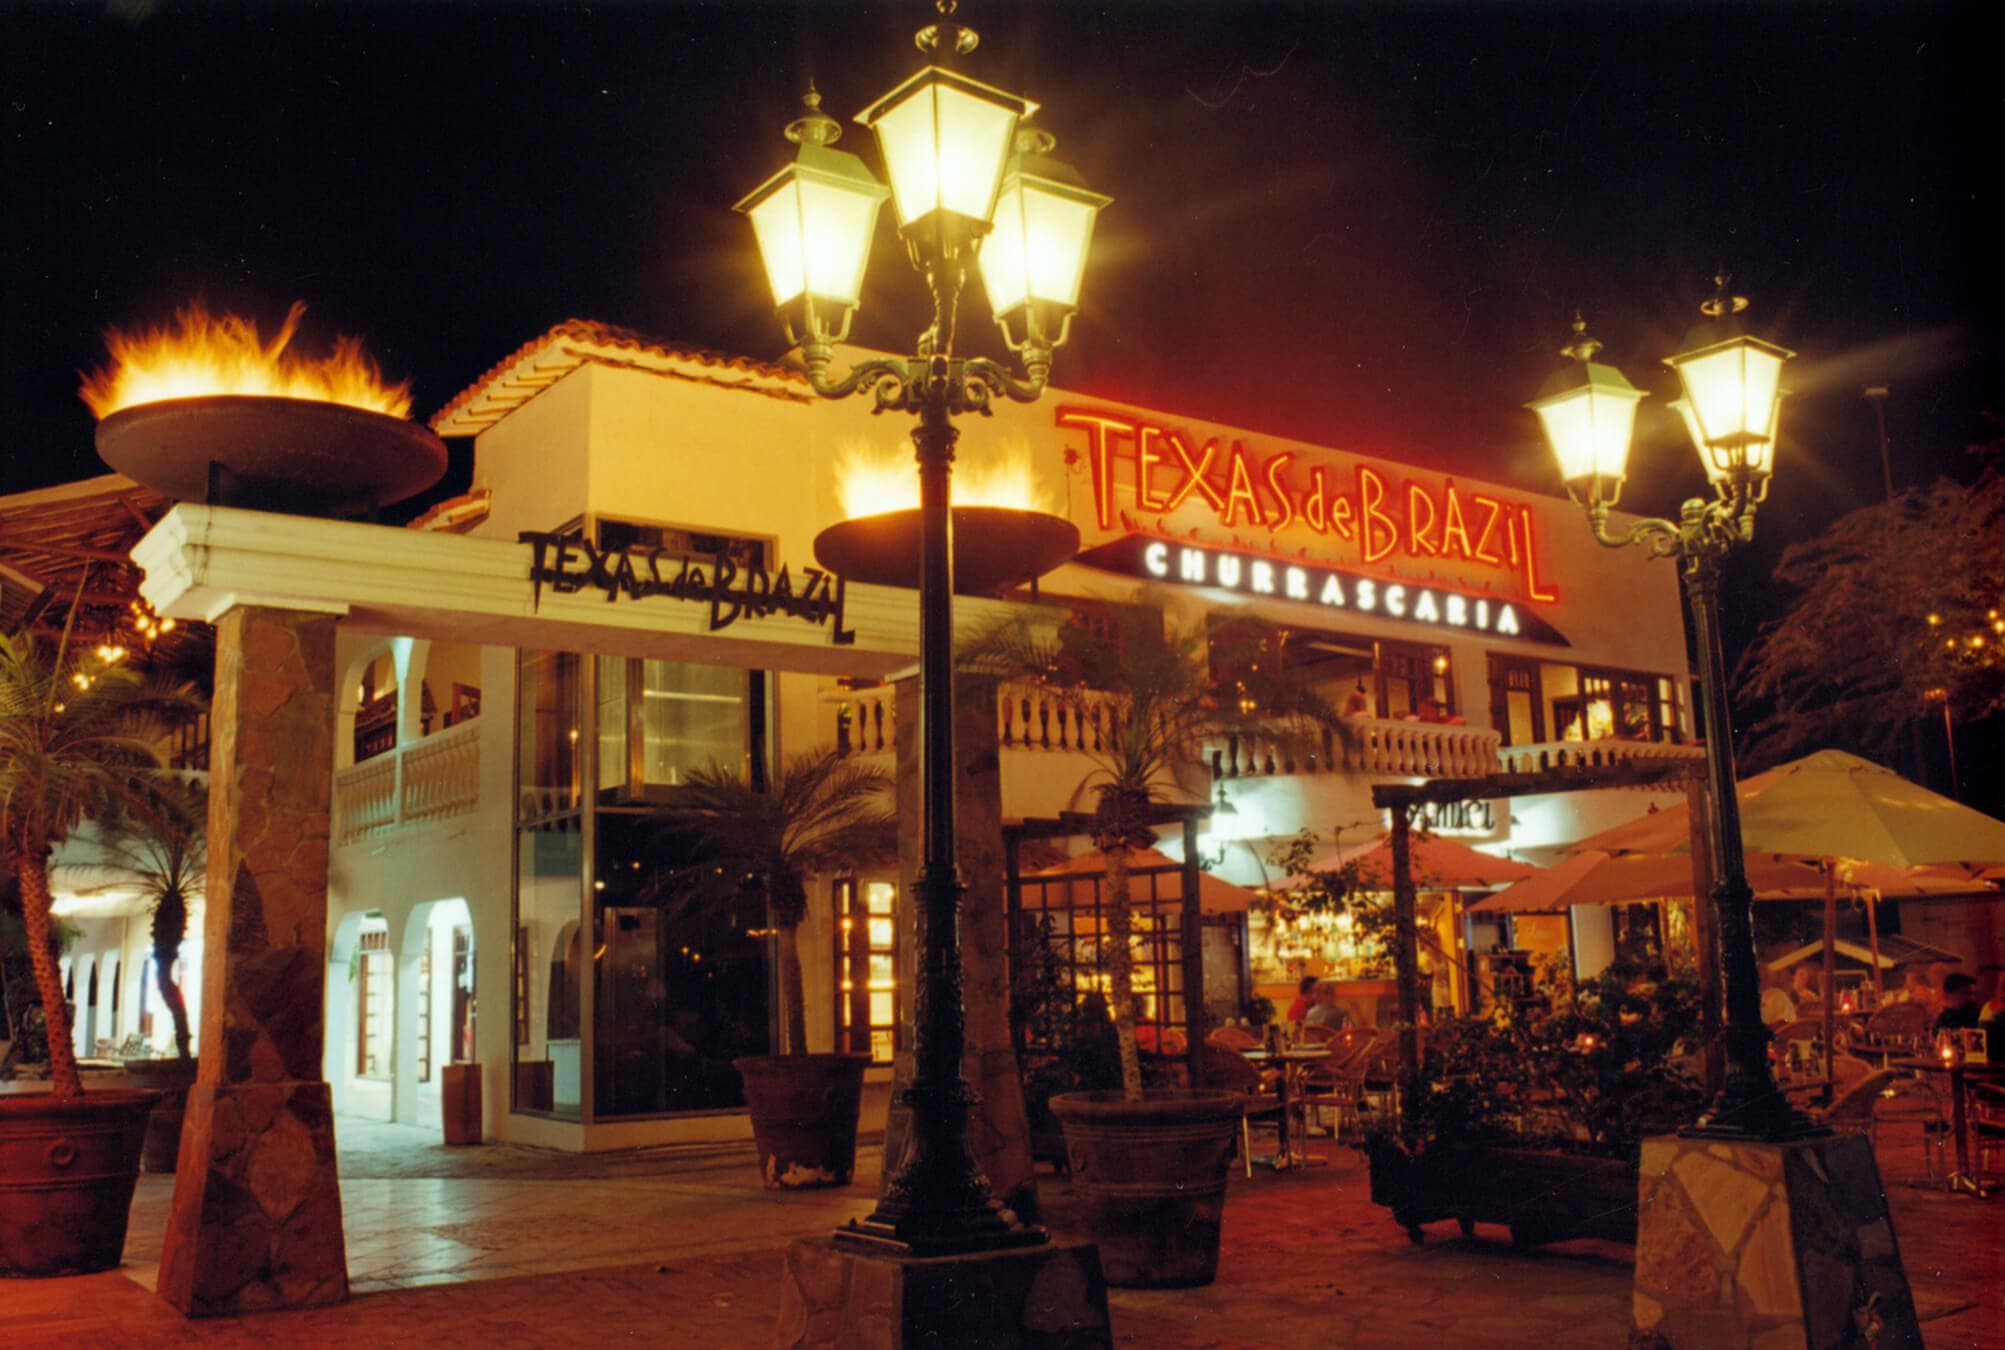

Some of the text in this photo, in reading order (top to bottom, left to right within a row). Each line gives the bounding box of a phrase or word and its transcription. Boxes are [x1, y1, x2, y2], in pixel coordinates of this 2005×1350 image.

[1056, 406, 1295, 535] TEXAS
[1302, 467, 1352, 540] de
[518, 531, 668, 614] TEXAS
[672, 556, 706, 600] de
[1144, 541, 1521, 635] CHURRASCARIA
